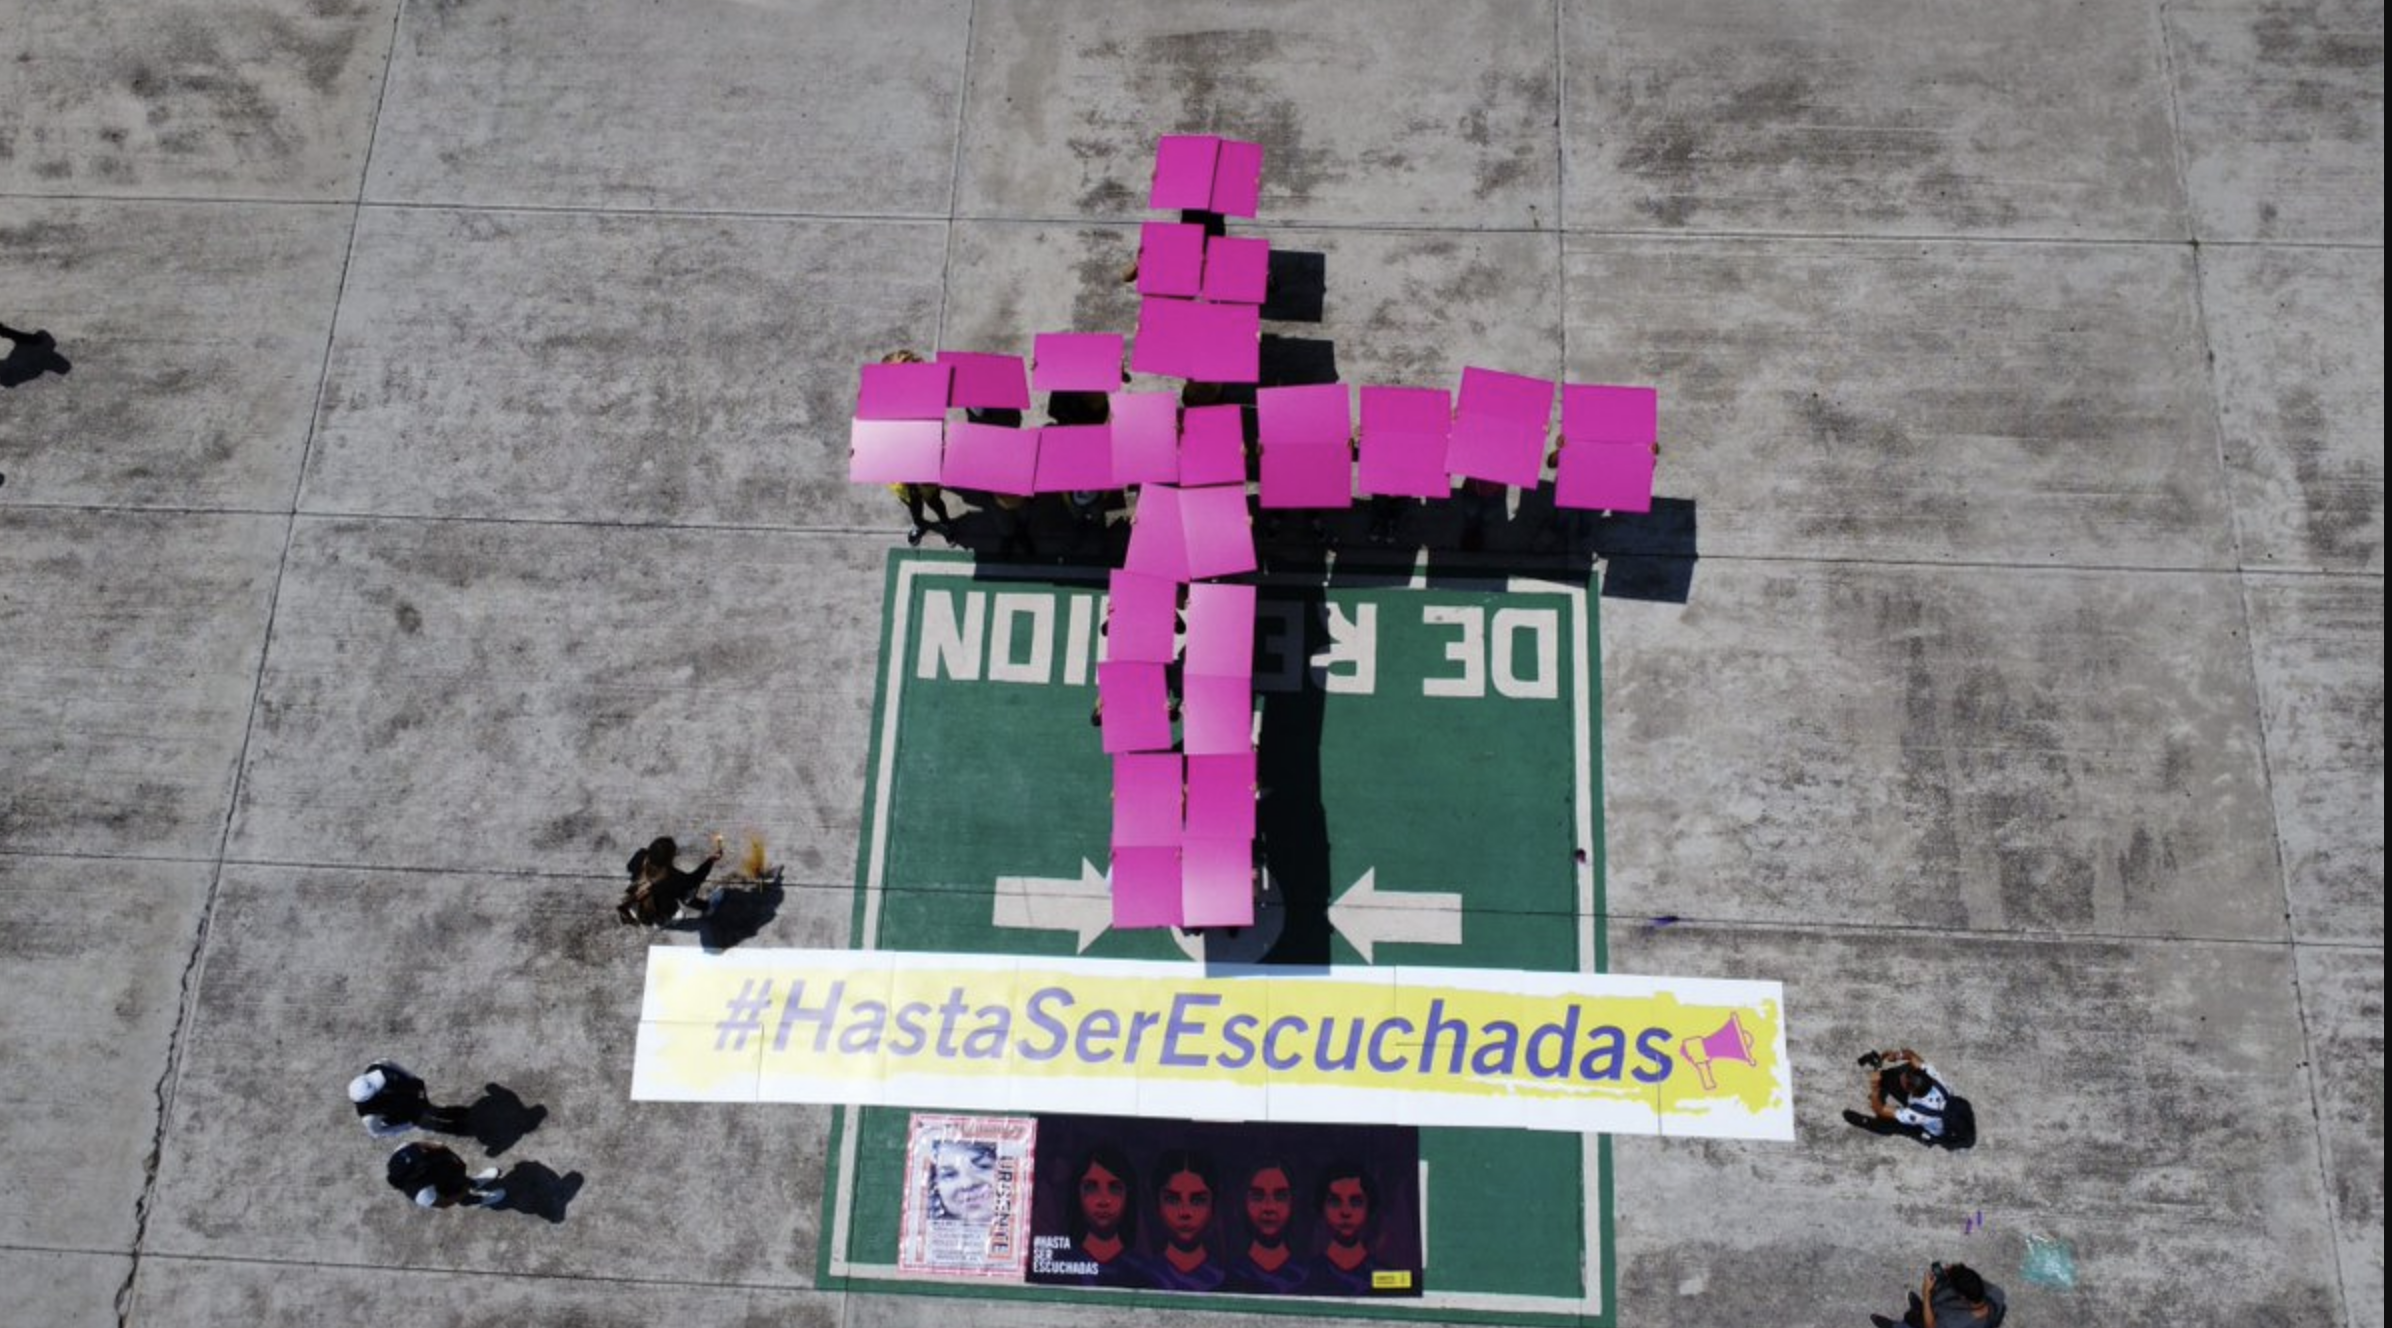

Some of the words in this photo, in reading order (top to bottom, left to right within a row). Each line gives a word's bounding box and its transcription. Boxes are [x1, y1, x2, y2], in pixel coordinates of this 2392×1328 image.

[917, 590, 1376, 695] REION
[1424, 605, 1558, 698] DE
[714, 978, 1674, 1083] #HastaSerEscuchadas
[1033, 1235, 1071, 1250] #HASTA
[1033, 1249, 1053, 1260] SER
[1033, 1261, 1099, 1275] ESCUCHADAS
